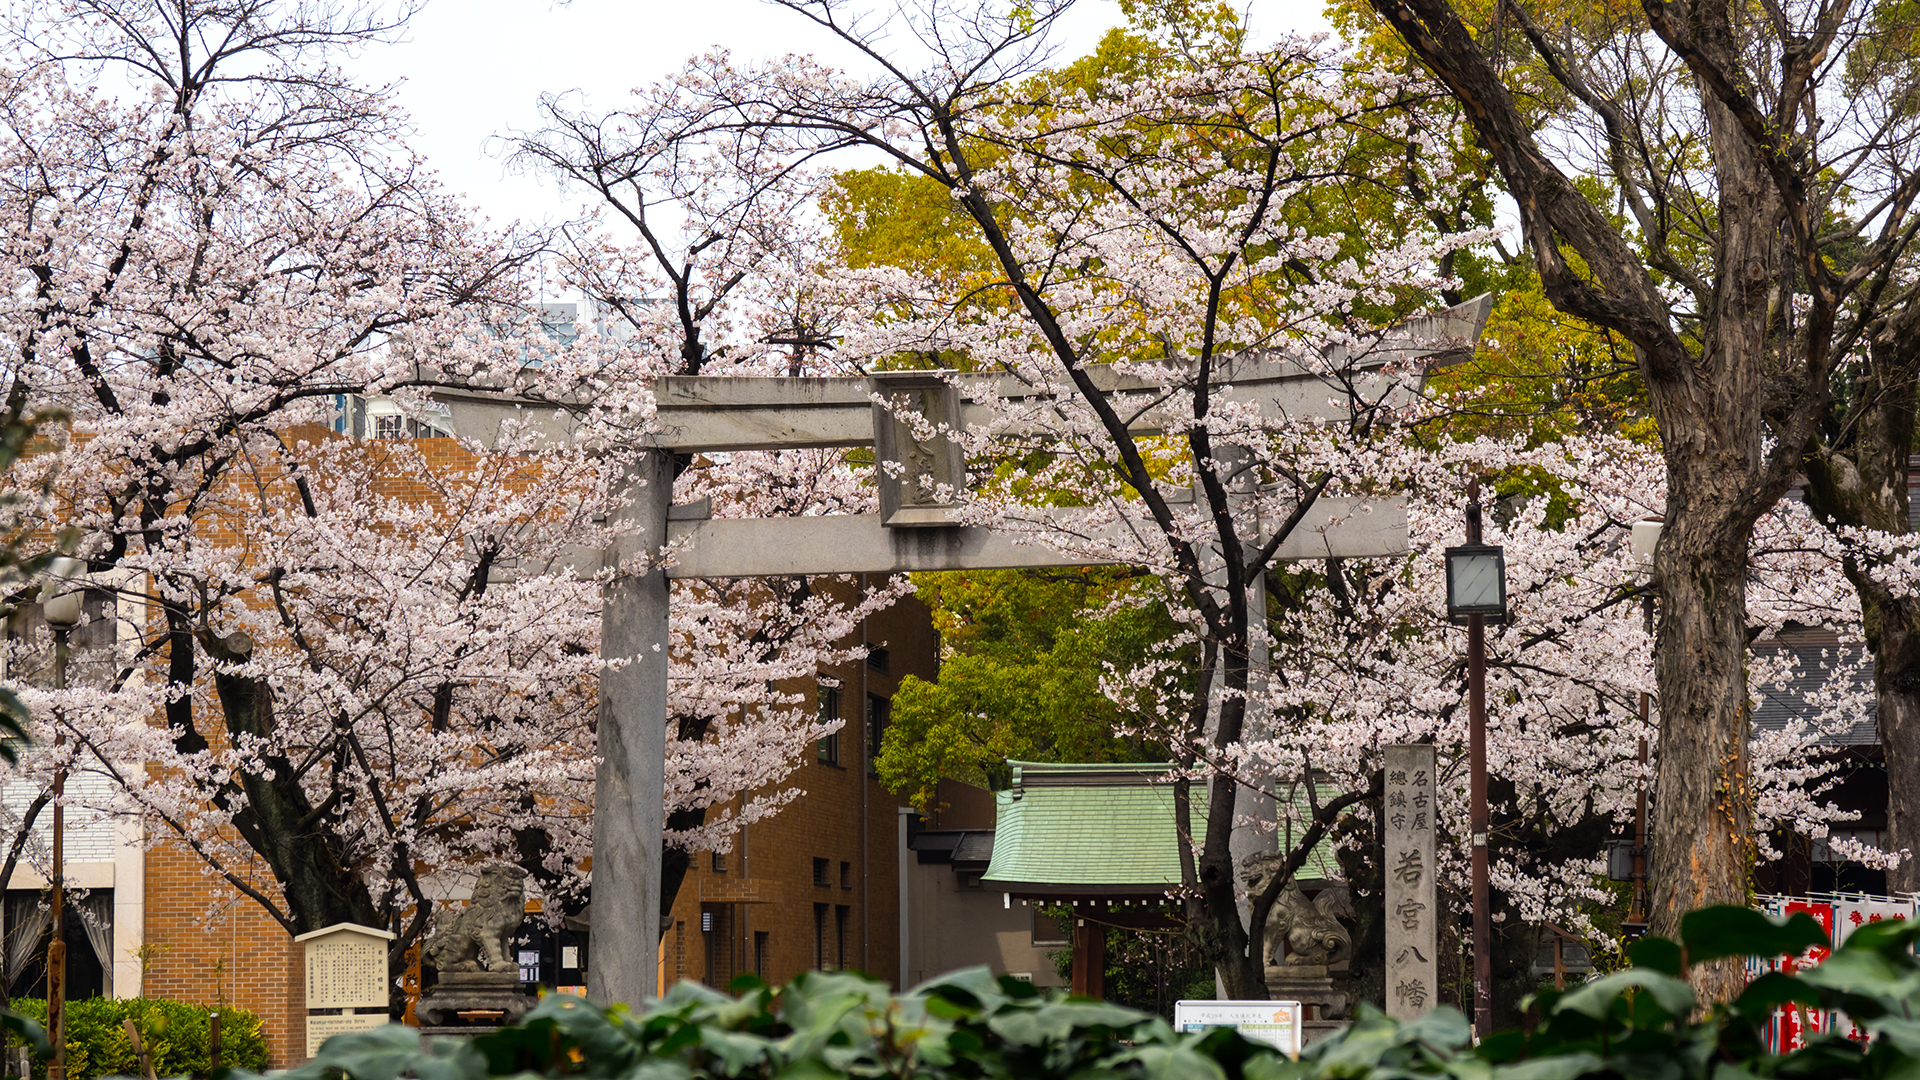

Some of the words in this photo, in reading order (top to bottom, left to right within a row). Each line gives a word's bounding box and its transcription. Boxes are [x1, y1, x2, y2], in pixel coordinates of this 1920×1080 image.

[1389, 770, 1408, 831] 總鎮守
[1411, 769, 1430, 831] 名古屋
[1393, 848, 1429, 1010] 若宮八幡
